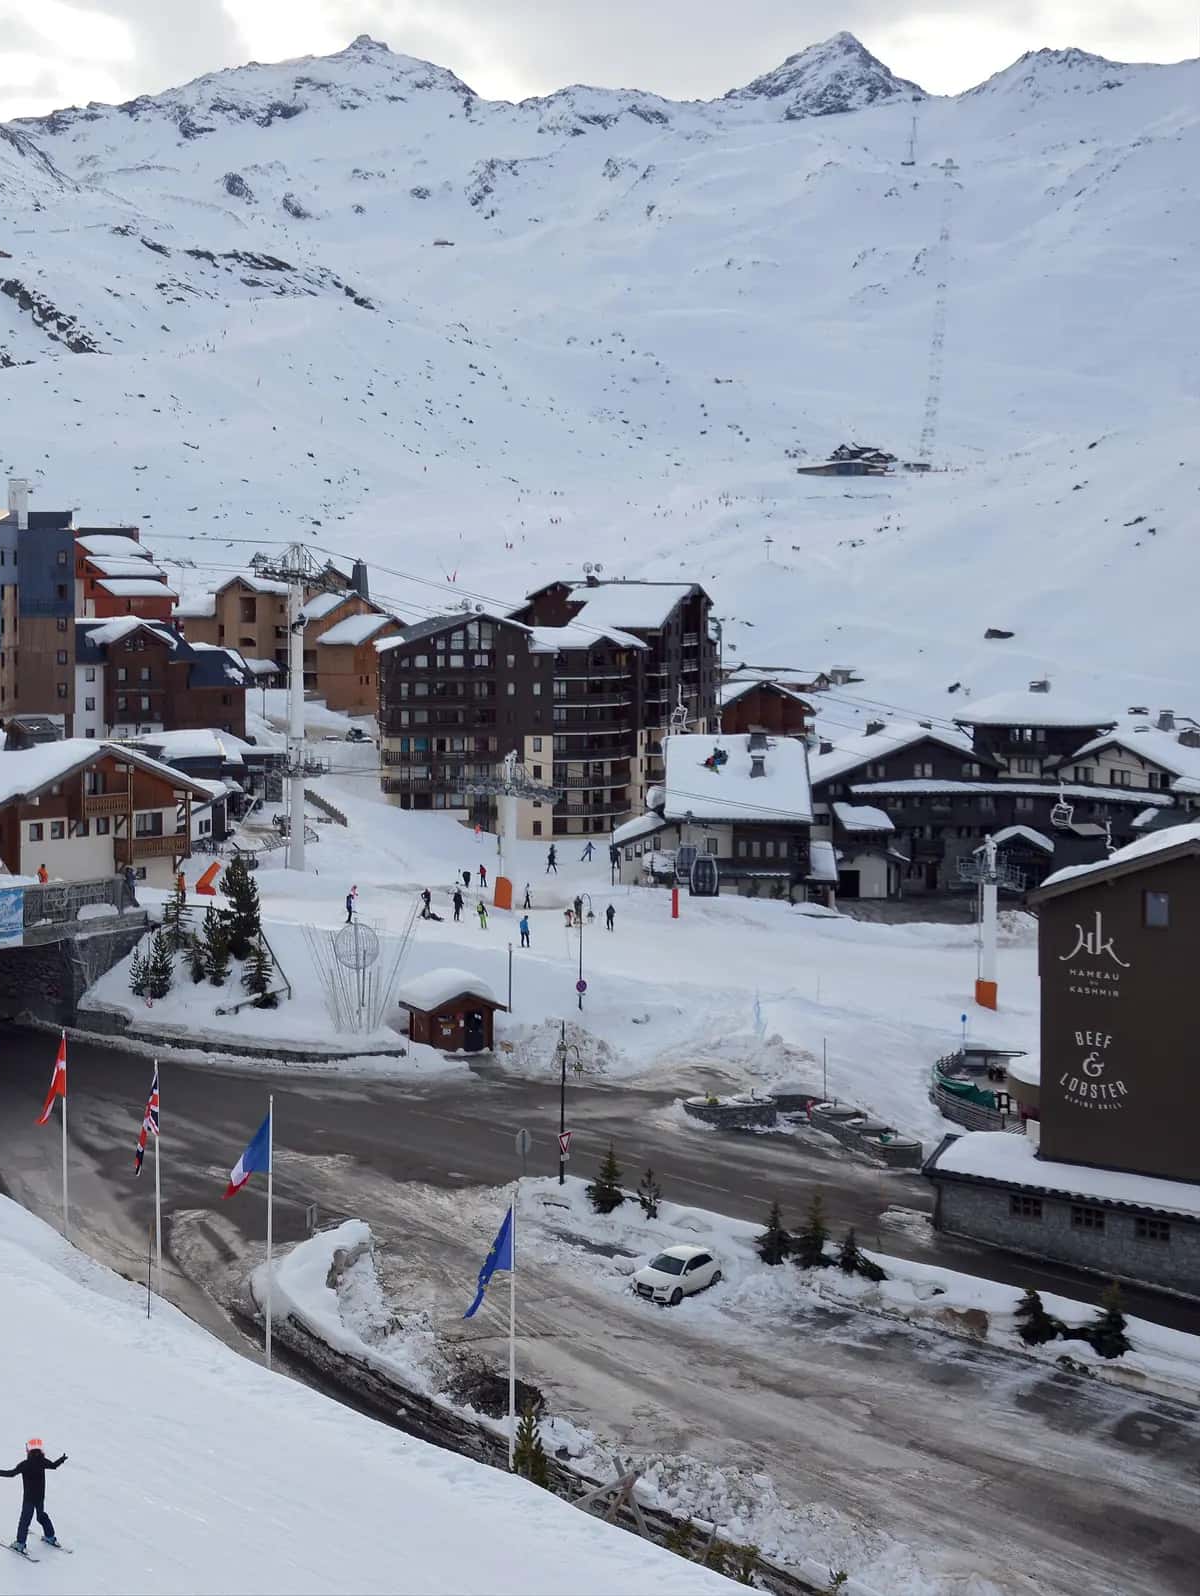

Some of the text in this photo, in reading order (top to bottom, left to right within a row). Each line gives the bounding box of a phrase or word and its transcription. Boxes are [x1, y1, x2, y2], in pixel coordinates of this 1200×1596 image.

[1069, 969, 1120, 981] HAMEAU
[1069, 985, 1120, 998] KASHMIR
[1075, 1031, 1112, 1049] BEEF
[1082, 1051, 1105, 1077] &
[1060, 1072, 1129, 1099] LOBSTER
